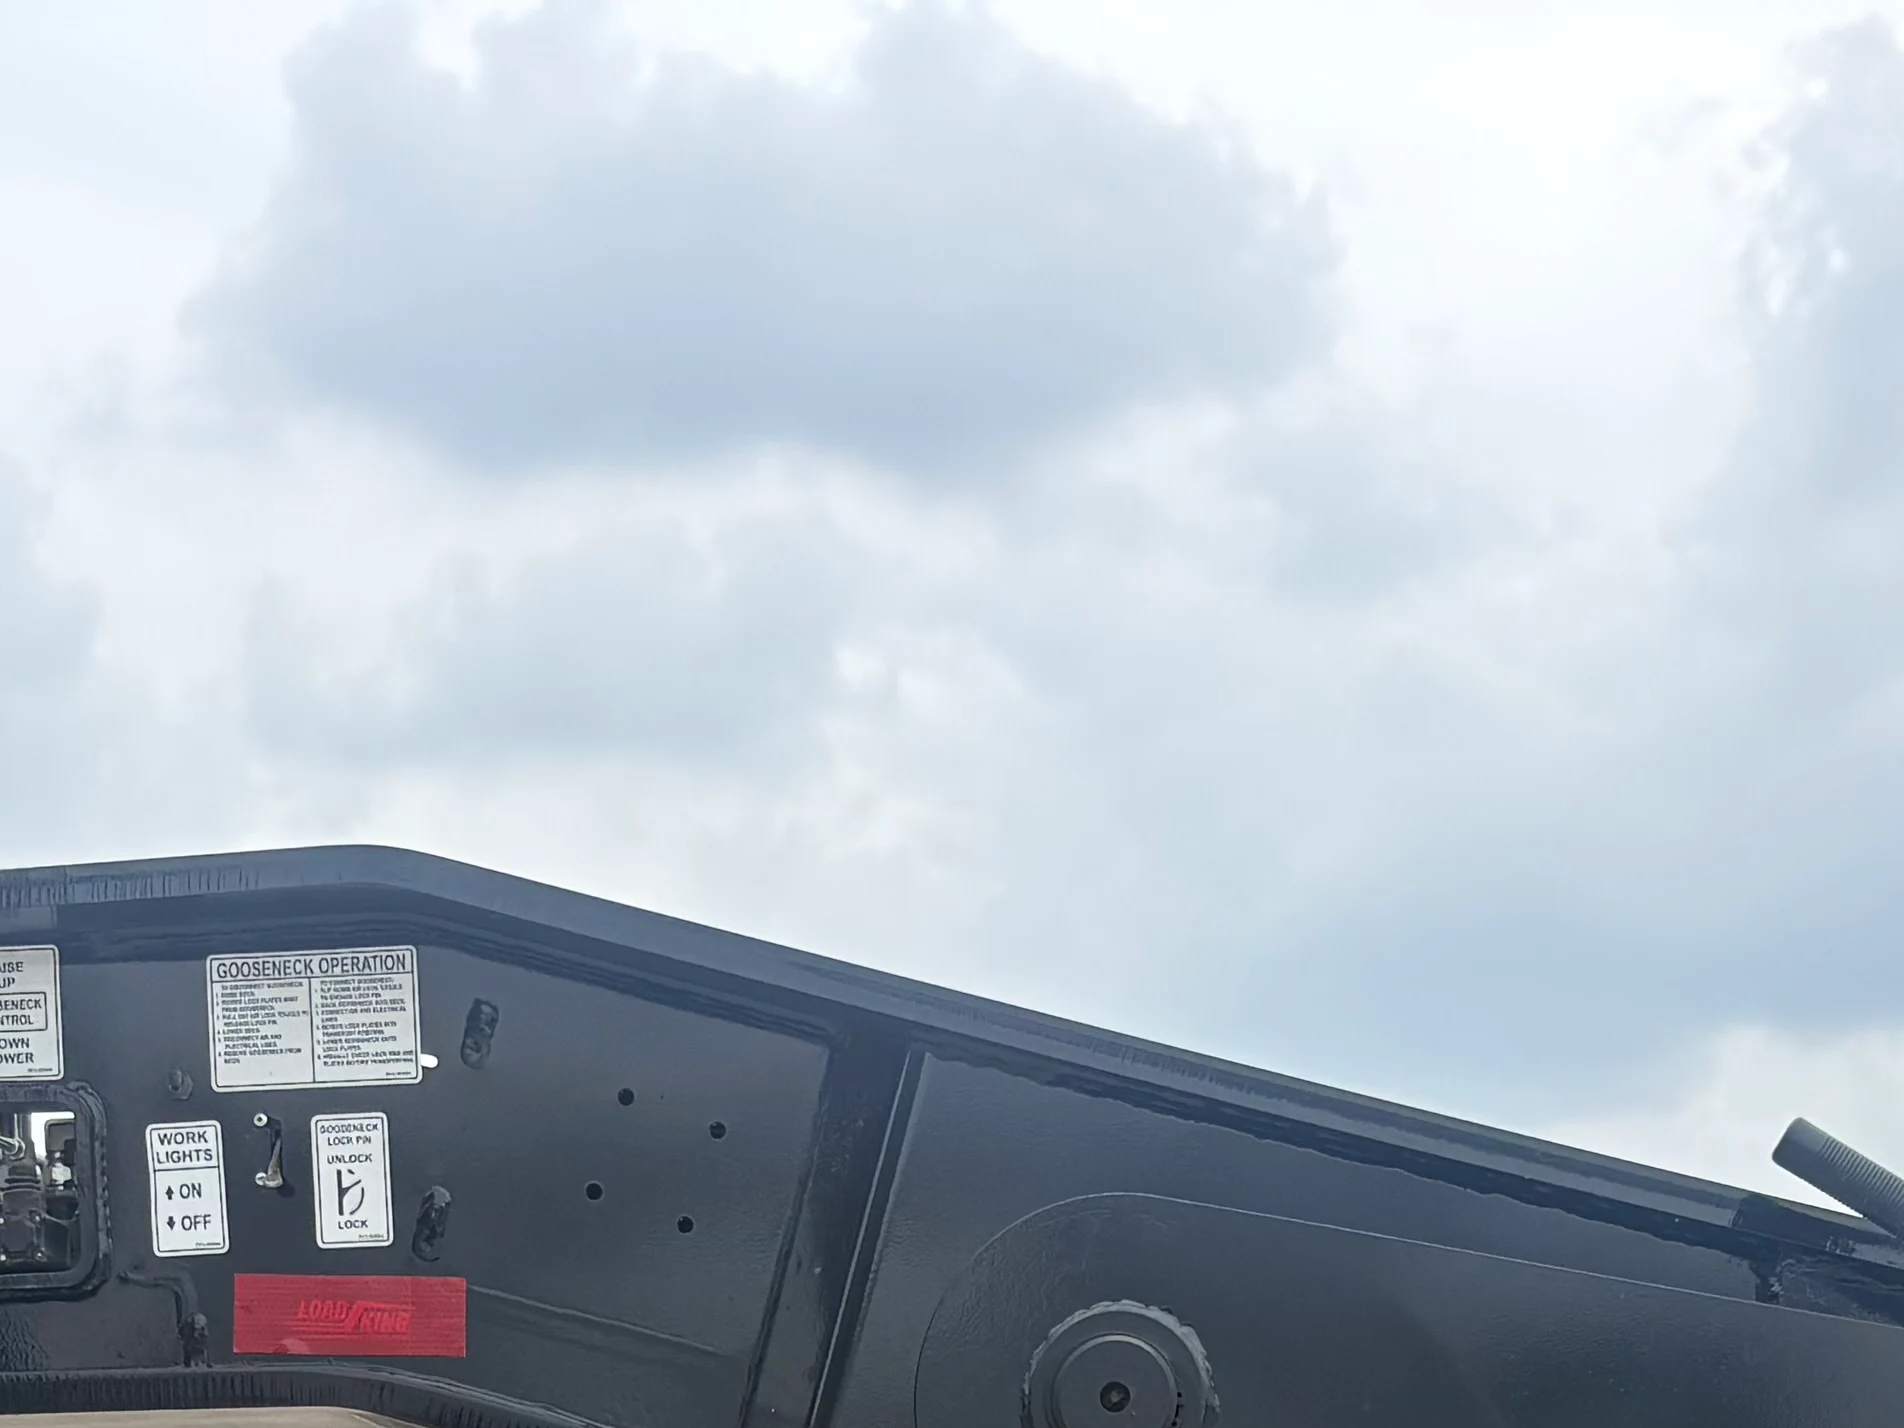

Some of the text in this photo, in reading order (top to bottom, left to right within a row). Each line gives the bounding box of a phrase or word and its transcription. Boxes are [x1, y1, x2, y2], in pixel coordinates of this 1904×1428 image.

[217, 954, 406, 978] GOOSENECK OPERATION
[158, 1131, 209, 1145] WORK
[156, 1149, 213, 1164] LIGHTS
[327, 1154, 372, 1164] UNLOCK
[179, 1183, 202, 1199] ON
[181, 1215, 212, 1231] OFF
[338, 1220, 368, 1229] LOCK
